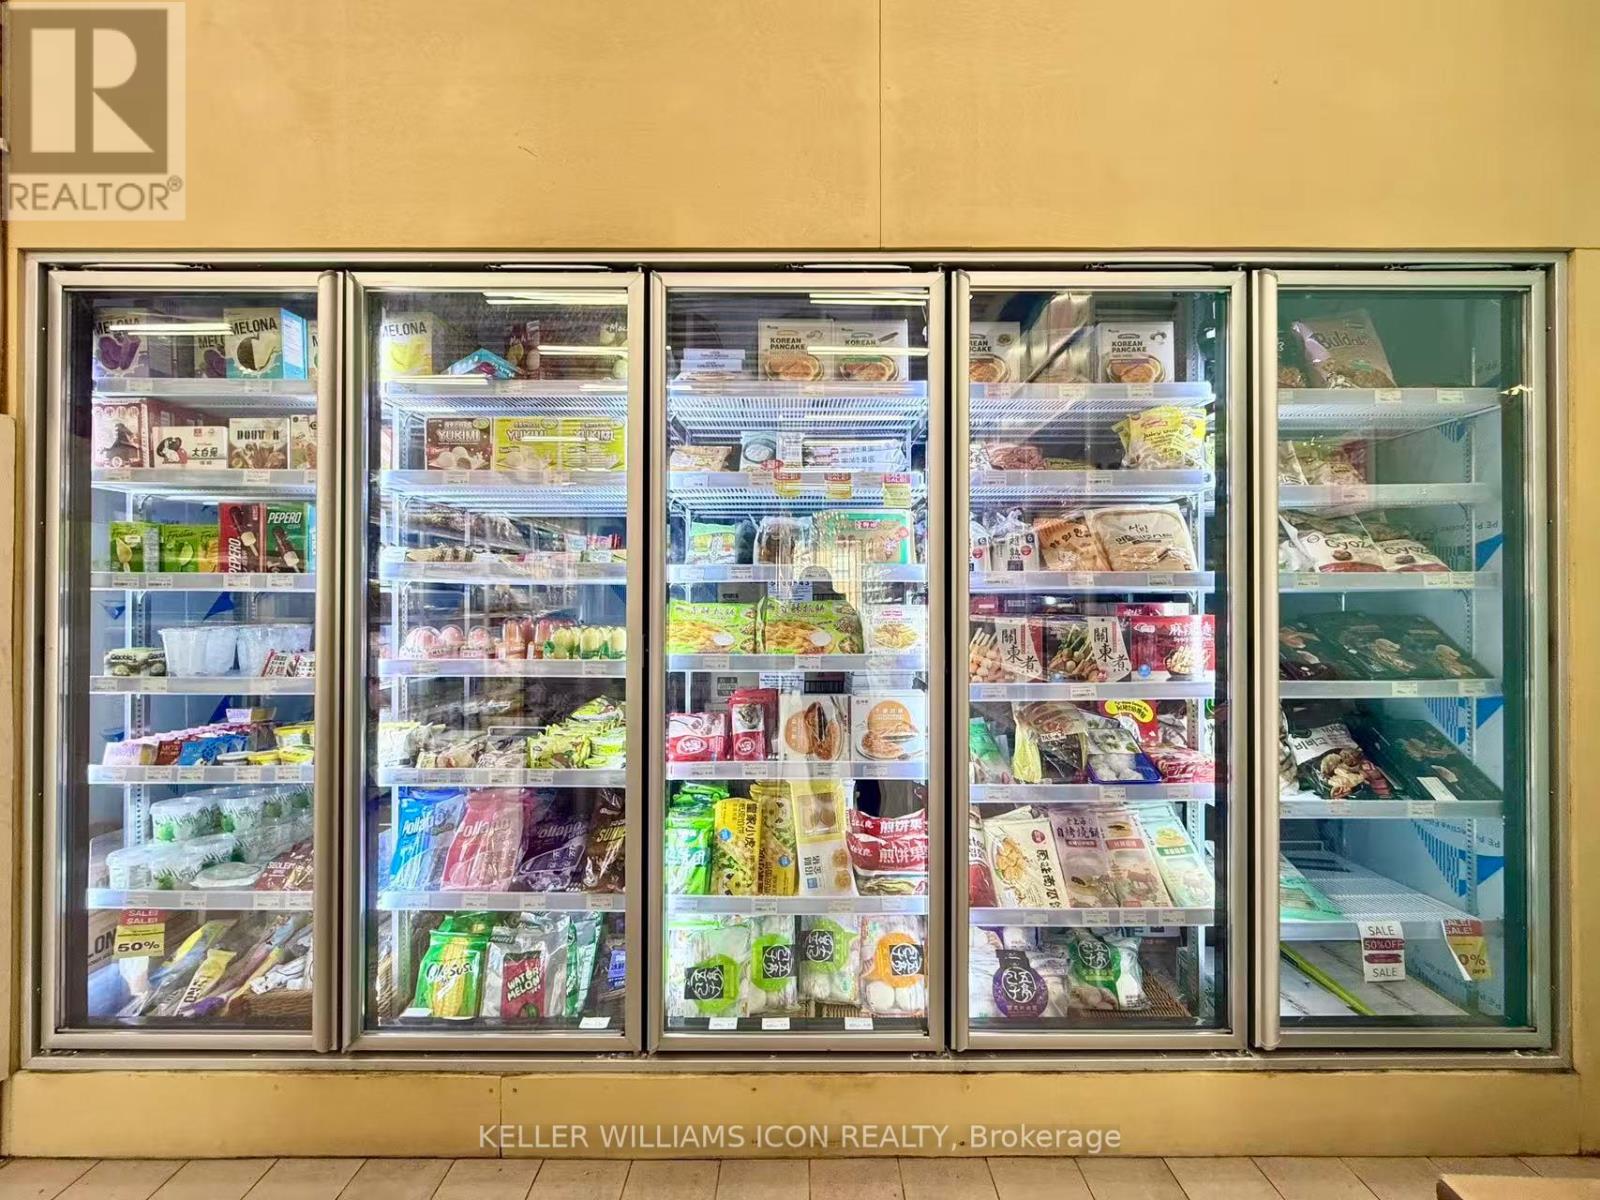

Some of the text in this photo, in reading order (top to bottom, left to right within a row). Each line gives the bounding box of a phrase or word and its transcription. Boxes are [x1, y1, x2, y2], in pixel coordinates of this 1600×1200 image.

[231, 317, 278, 336] MELONA
[438, 429, 480, 441] YUKIMI
[267, 511, 302, 524] PEPERO
[1368, 926, 1396, 936] SALE
[118, 941, 160, 952] 50%
[1373, 967, 1398, 977] SALE
[508, 976, 541, 1001] MELON
